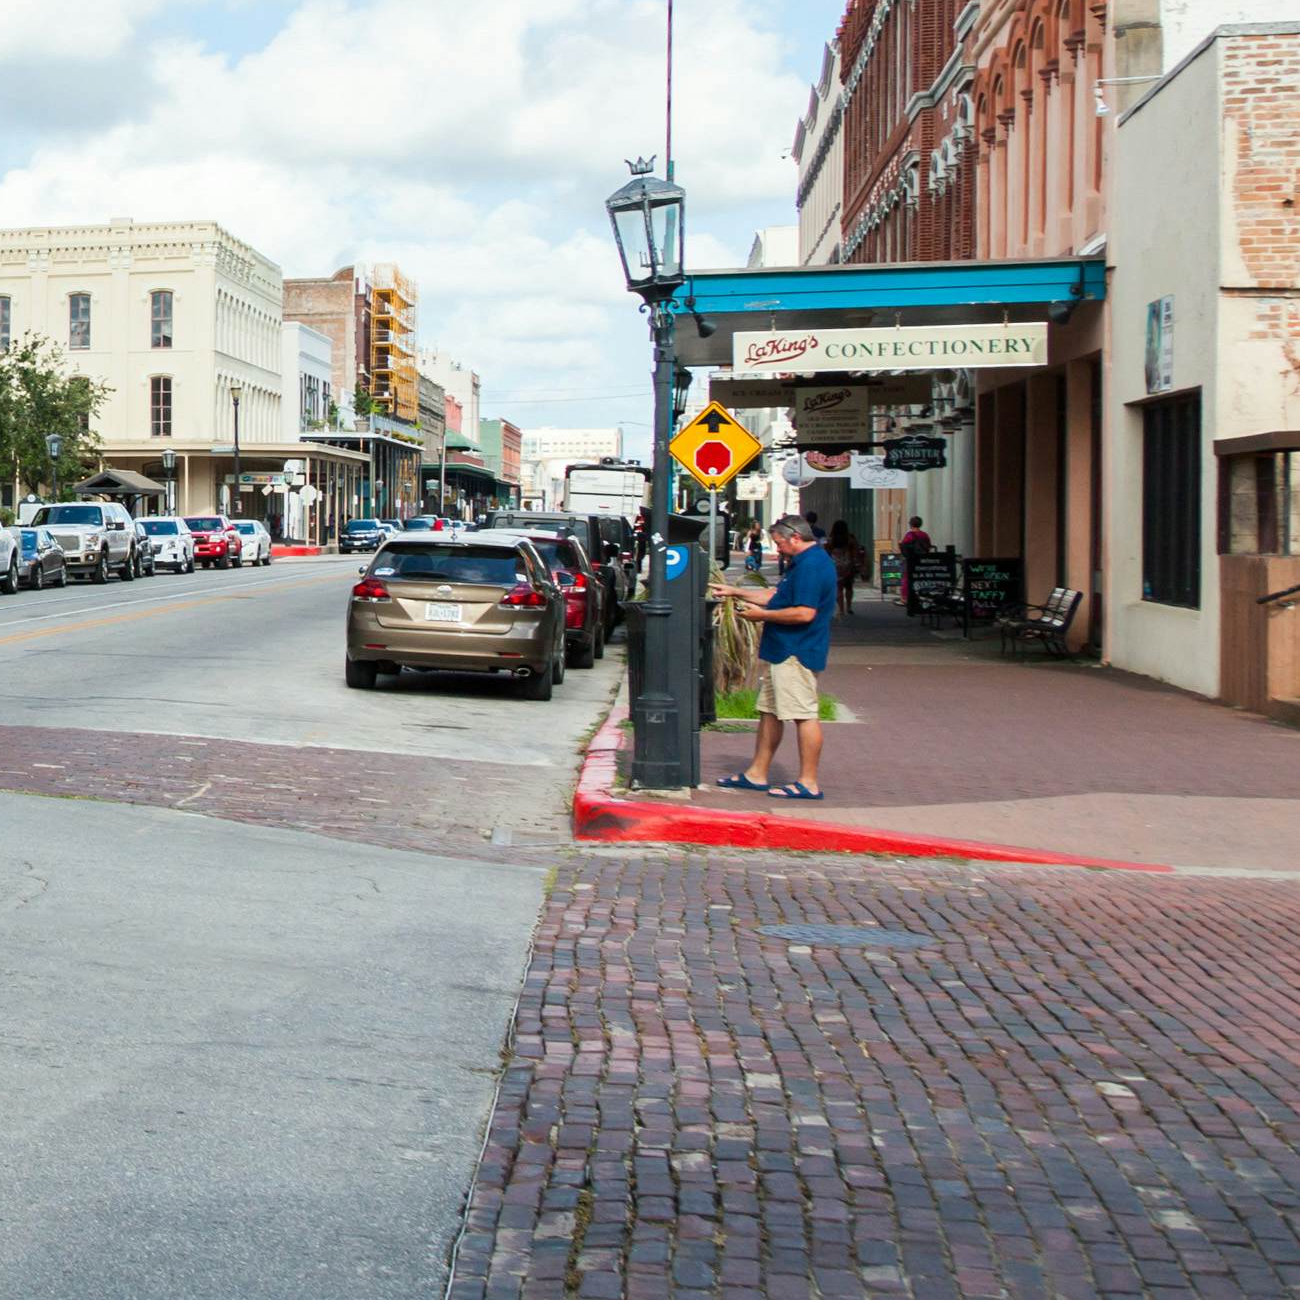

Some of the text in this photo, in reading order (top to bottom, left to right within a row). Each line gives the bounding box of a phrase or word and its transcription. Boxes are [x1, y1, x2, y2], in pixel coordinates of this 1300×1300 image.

[744, 334, 1036, 367] LaKing's CONFECTIONERY
[970, 590, 1006, 600] TAFFY
